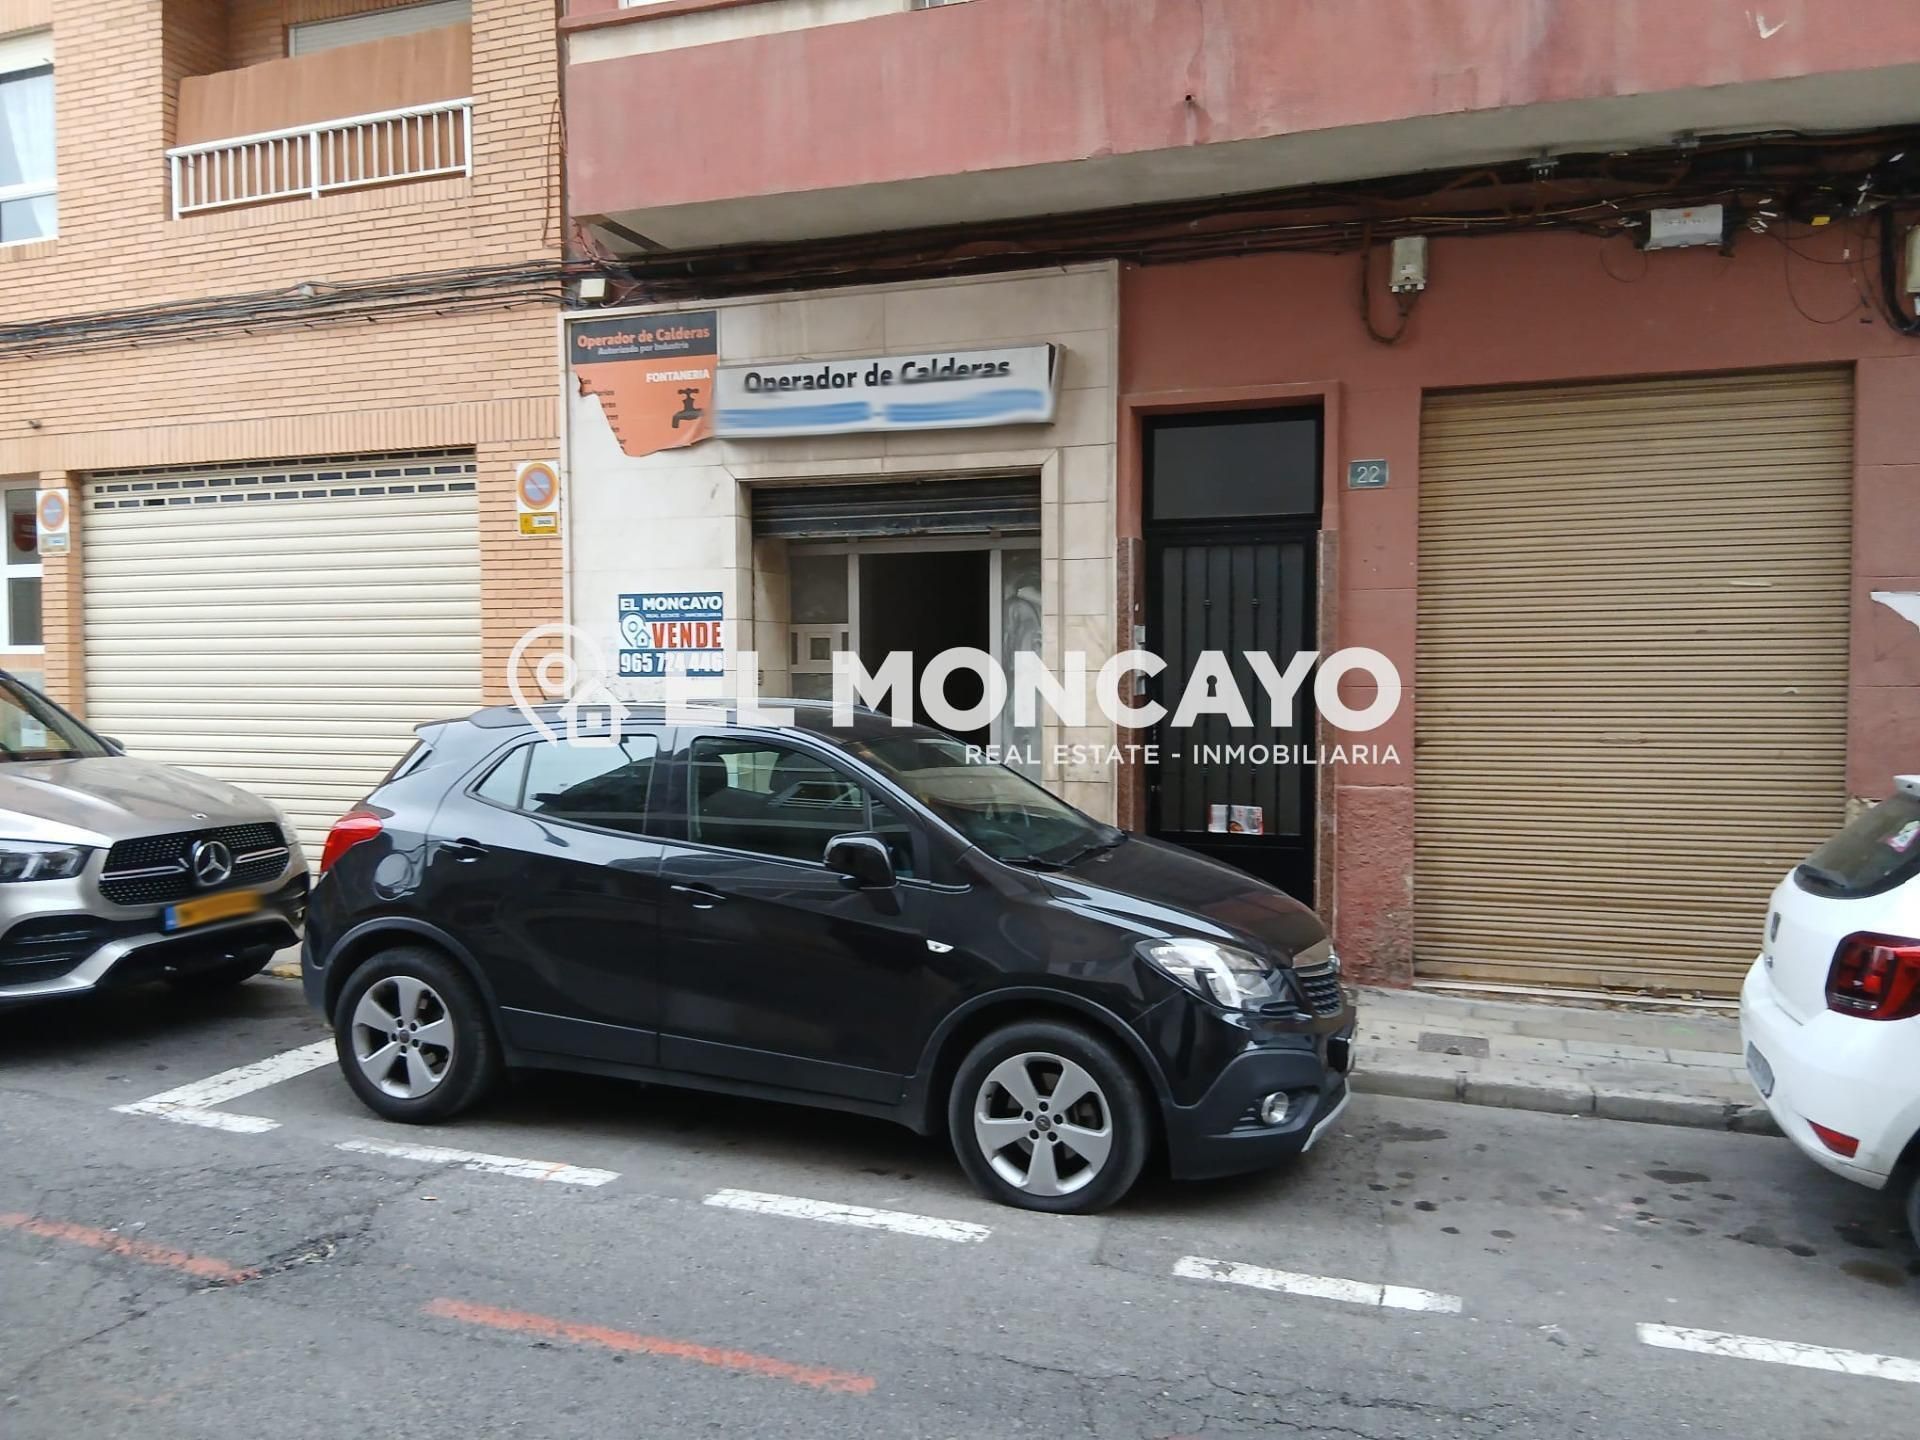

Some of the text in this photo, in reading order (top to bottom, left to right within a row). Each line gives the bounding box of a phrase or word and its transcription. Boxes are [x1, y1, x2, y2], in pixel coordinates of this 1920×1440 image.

[577, 326, 710, 350] Operador de Calderas
[864, 362, 893, 387] de
[1357, 465, 1380, 483] 22
[620, 595, 723, 611] EL MONCAYO
[652, 621, 721, 649] VENDE
[620, 652, 653, 673] 965
